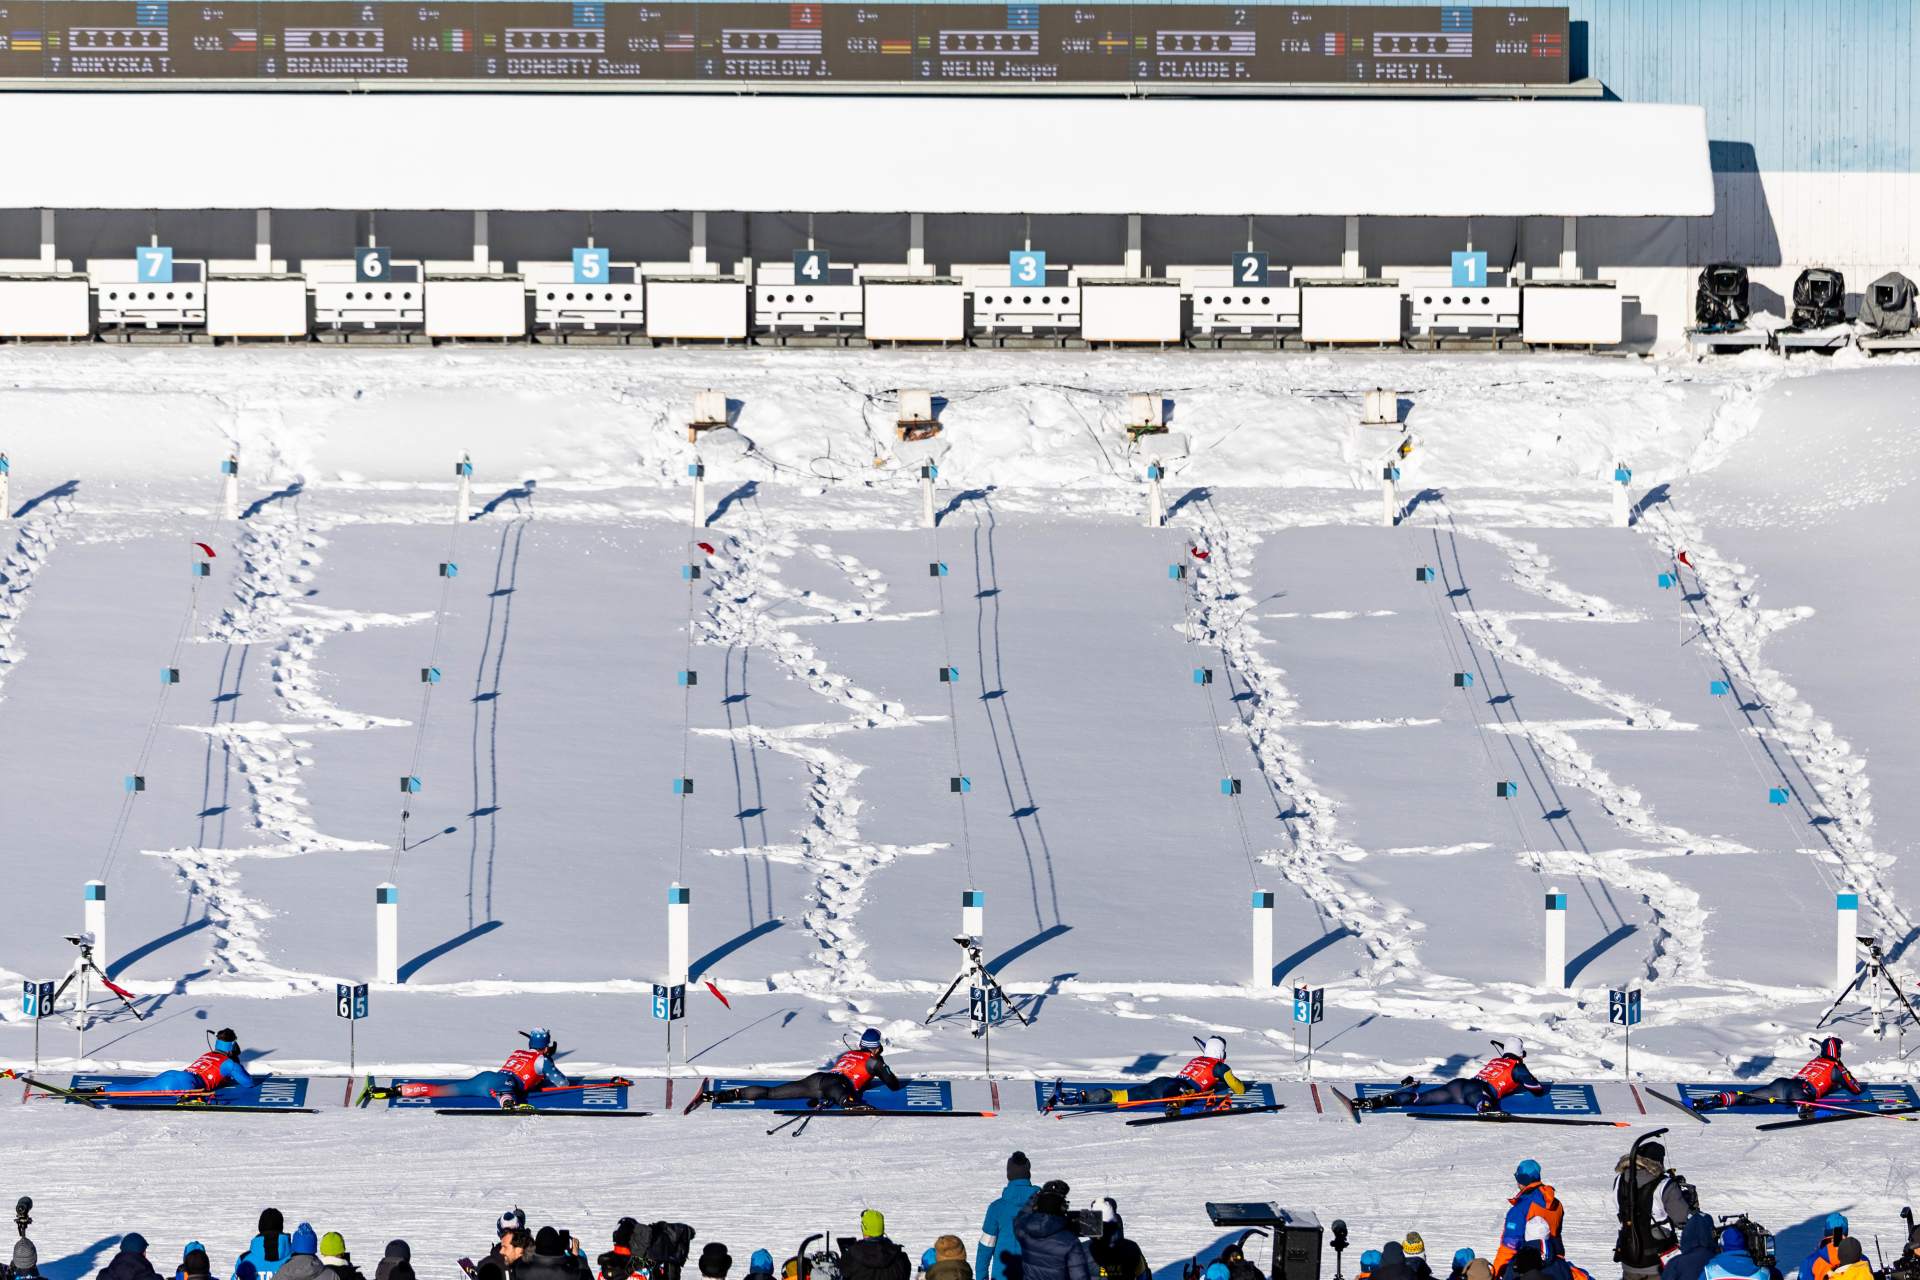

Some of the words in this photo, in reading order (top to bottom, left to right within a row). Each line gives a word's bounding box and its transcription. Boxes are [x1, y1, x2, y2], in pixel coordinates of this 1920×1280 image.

[146, 5, 158, 20] 7
[583, 7, 595, 22] 5
[1017, 9, 1029, 24] 3
[1234, 9, 1246, 25] 2
[1452, 11, 1461, 27] 1
[71, 57, 154, 73] MIKYSKA
[286, 57, 409, 74] BRAUNHOFER
[507, 58, 592, 74] DOHERTY
[598, 58, 640, 75] Sean
[725, 59, 811, 76] STRELOW
[941, 60, 995, 77] NELIN
[1000, 60, 1060, 82] Jesper
[1138, 61, 1148, 77] 2
[1159, 61, 1230, 78] CLAUDE
[1235, 61, 1251, 78] F.
[1355, 62, 1363, 79] 1
[1375, 62, 1419, 79] FREY
[145, 252, 164, 278] 7
[363, 252, 382, 278] 6
[581, 253, 600, 279] 5
[802, 255, 821, 280] 4
[1018, 256, 1037, 281] 3
[1241, 257, 1259, 282] 2
[1463, 257, 1476, 282] 1
[25, 994, 35, 1014] 7
[41, 995, 51, 1015] 6
[340, 998, 349, 1017] 6
[356, 997, 366, 1017] 5
[656, 998, 666, 1018] 5
[672, 998, 682, 1018] 4
[973, 1001, 983, 1021] 4
[990, 1001, 999, 1021] 3
[1297, 1002, 1307, 1022] 3
[1313, 1002, 1321, 1022] 2
[1612, 1004, 1623, 1024] 2
[1631, 1004, 1638, 1024] 1
[259, 1082, 297, 1103] BMW
[582, 1086, 618, 1105] BMW
[906, 1085, 943, 1106] BMW
[1550, 1089, 1590, 1110] BMW
